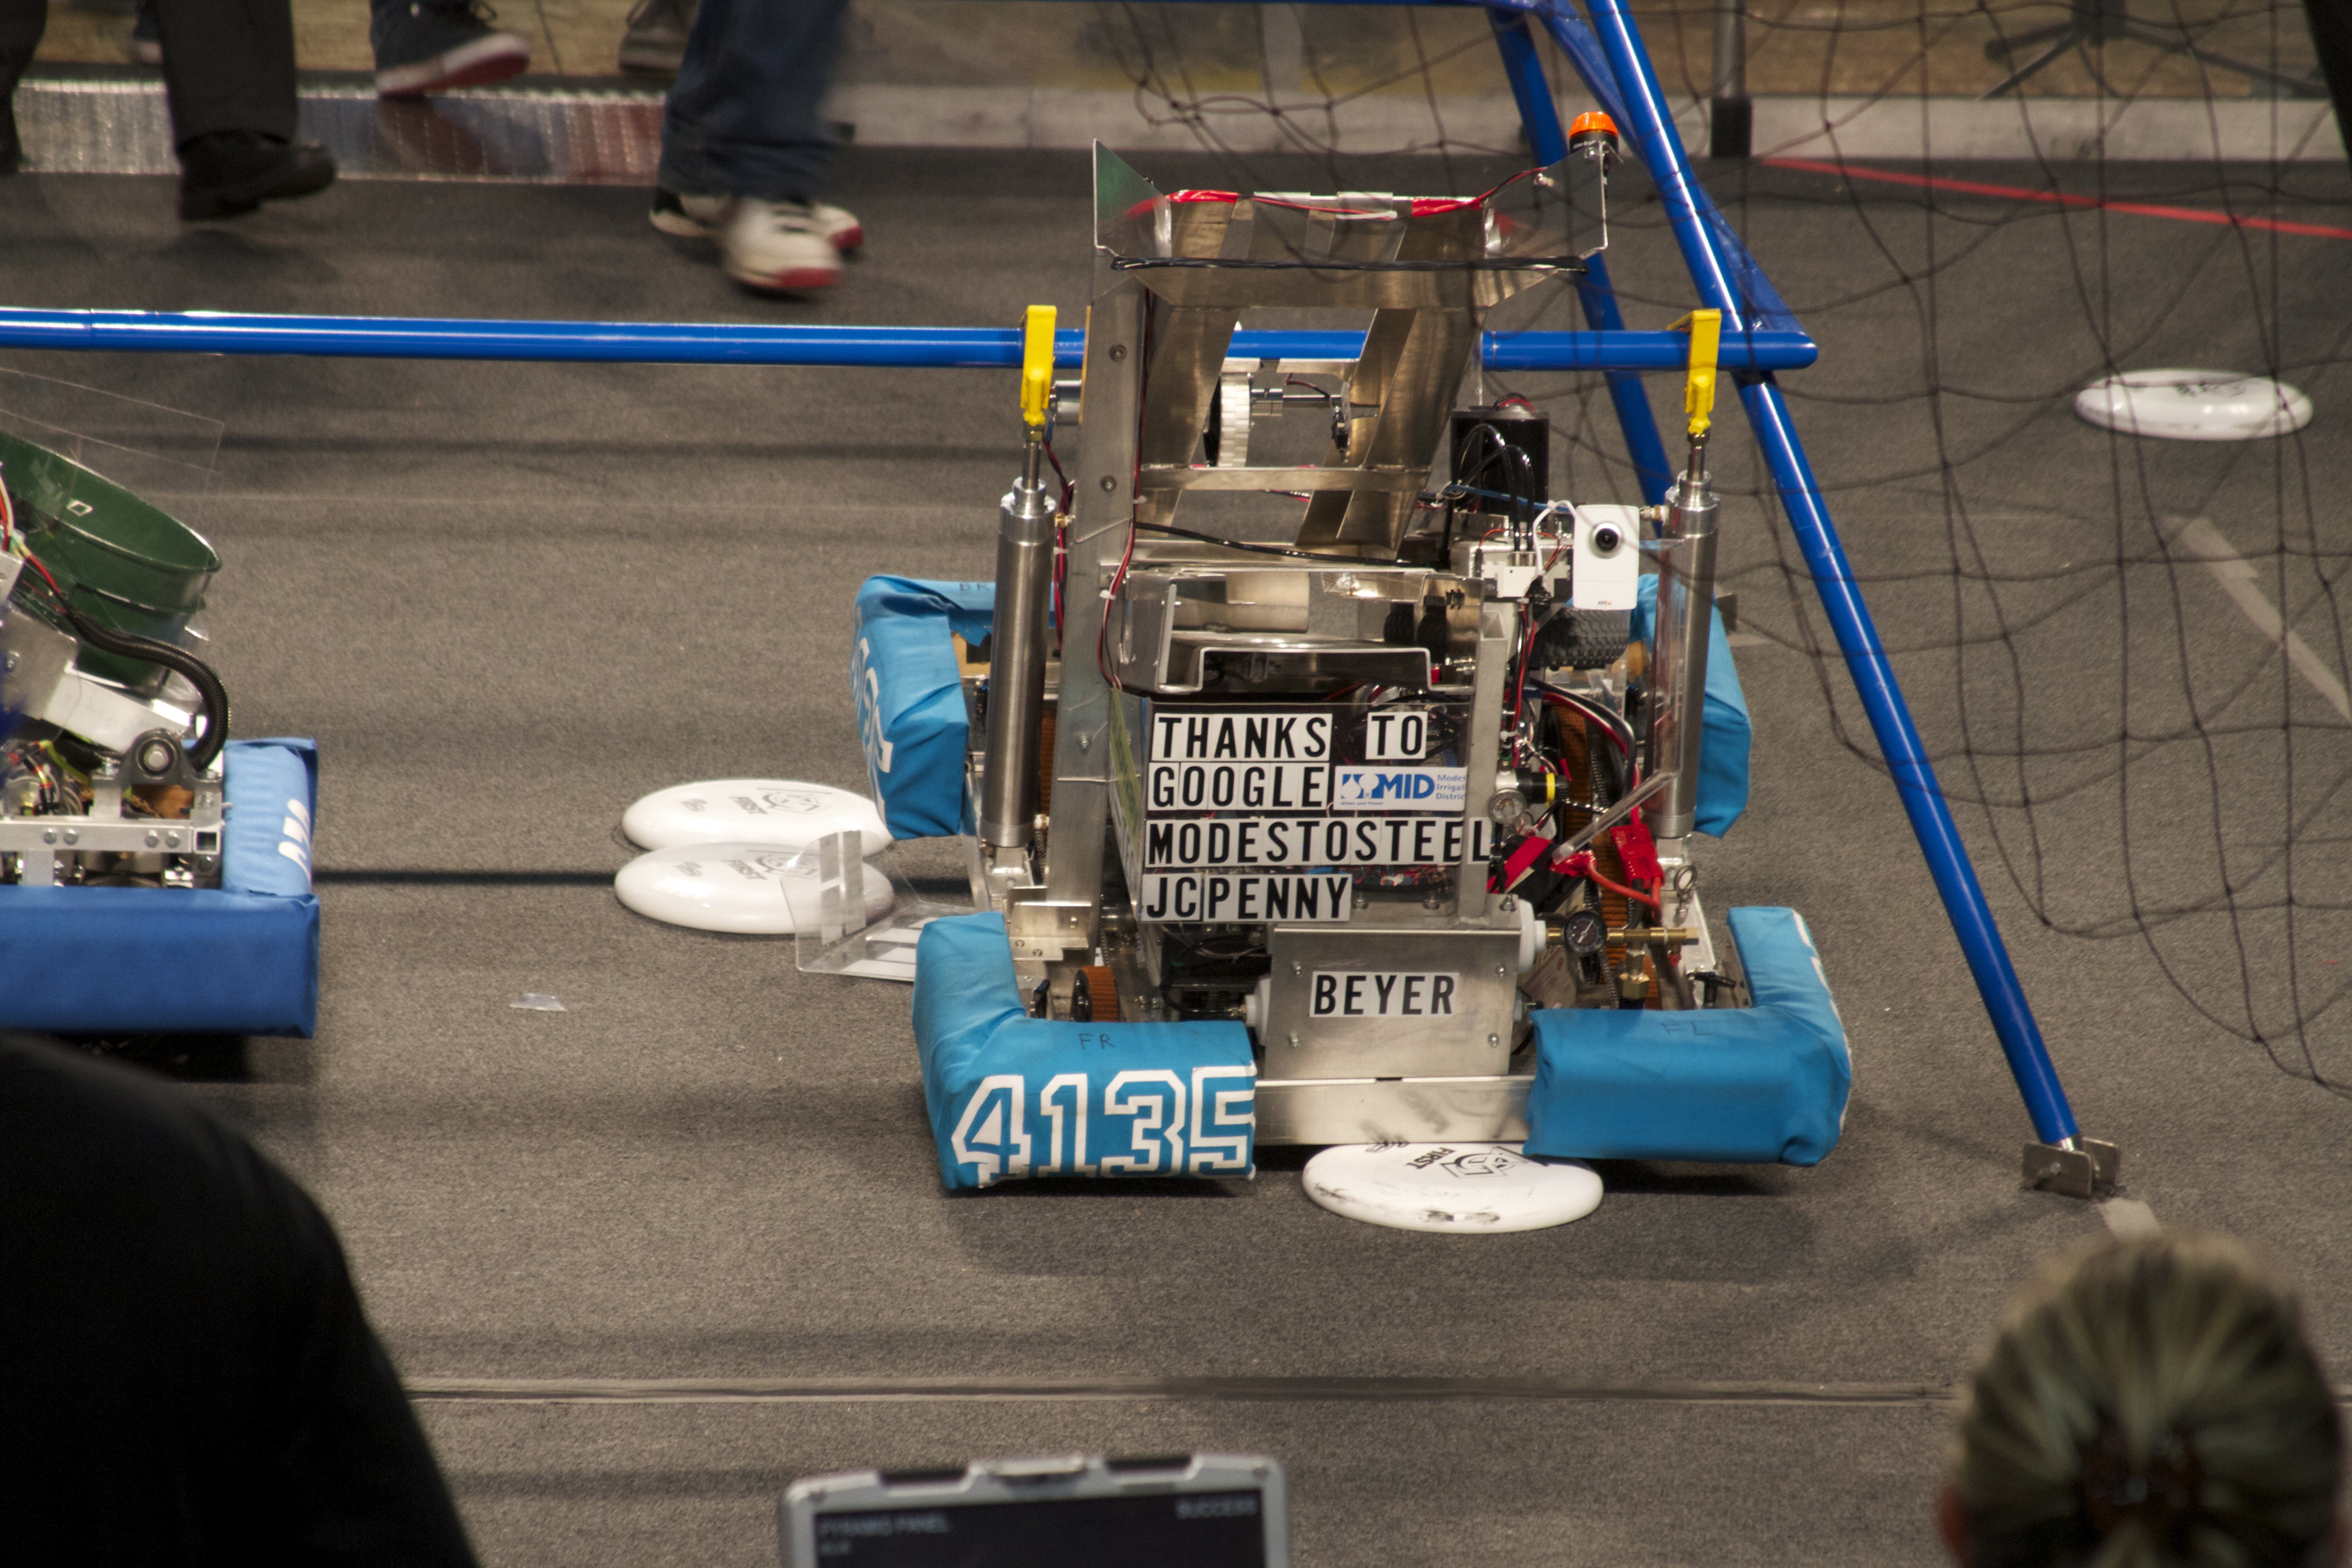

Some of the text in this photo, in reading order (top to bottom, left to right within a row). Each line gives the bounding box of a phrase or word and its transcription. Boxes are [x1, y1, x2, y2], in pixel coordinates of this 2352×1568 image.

[1158, 714, 1422, 759] THANKS TO
[1153, 766, 1324, 808] GOOGLE
[1372, 774, 1436, 799] MID
[1148, 820, 1490, 864] MODESTOSTEEL
[1147, 877, 1348, 919] JCPENNY
[1314, 975, 1455, 1015] BEYER
[1078, 1033, 1115, 1049] FR
[1660, 1020, 1714, 1036] FL
[1406, 1147, 1457, 1170] FIRST
